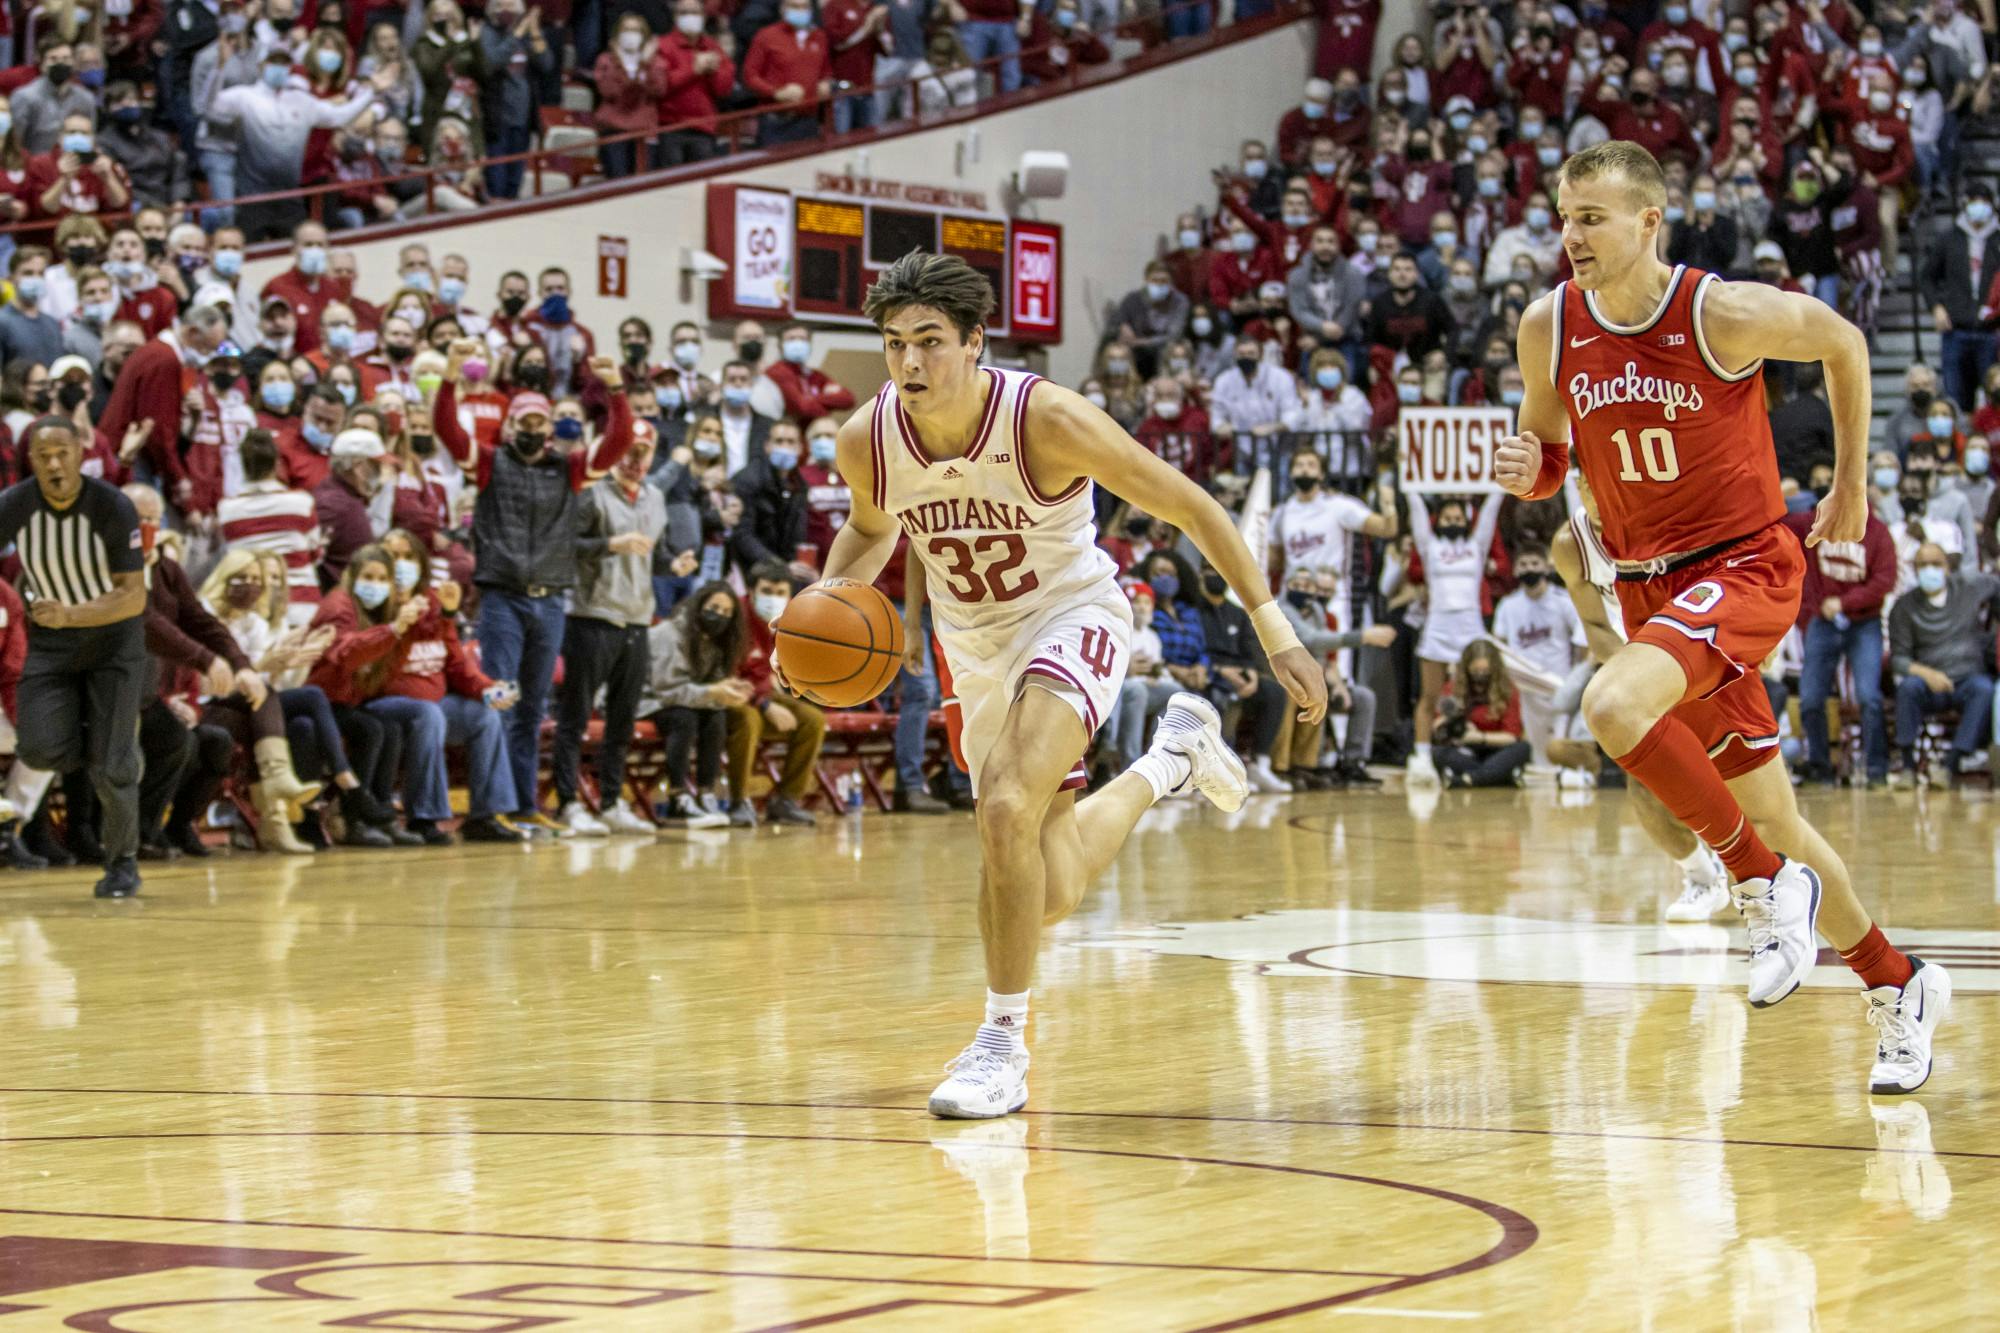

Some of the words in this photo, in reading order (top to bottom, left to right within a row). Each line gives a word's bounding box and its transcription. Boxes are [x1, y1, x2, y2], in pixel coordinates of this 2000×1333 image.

[747, 226, 777, 257] GO
[606, 257, 618, 291] 9
[1569, 361, 1704, 421] Buckeyes
[1610, 427, 1680, 482] 10
[928, 533, 1040, 603] 32
